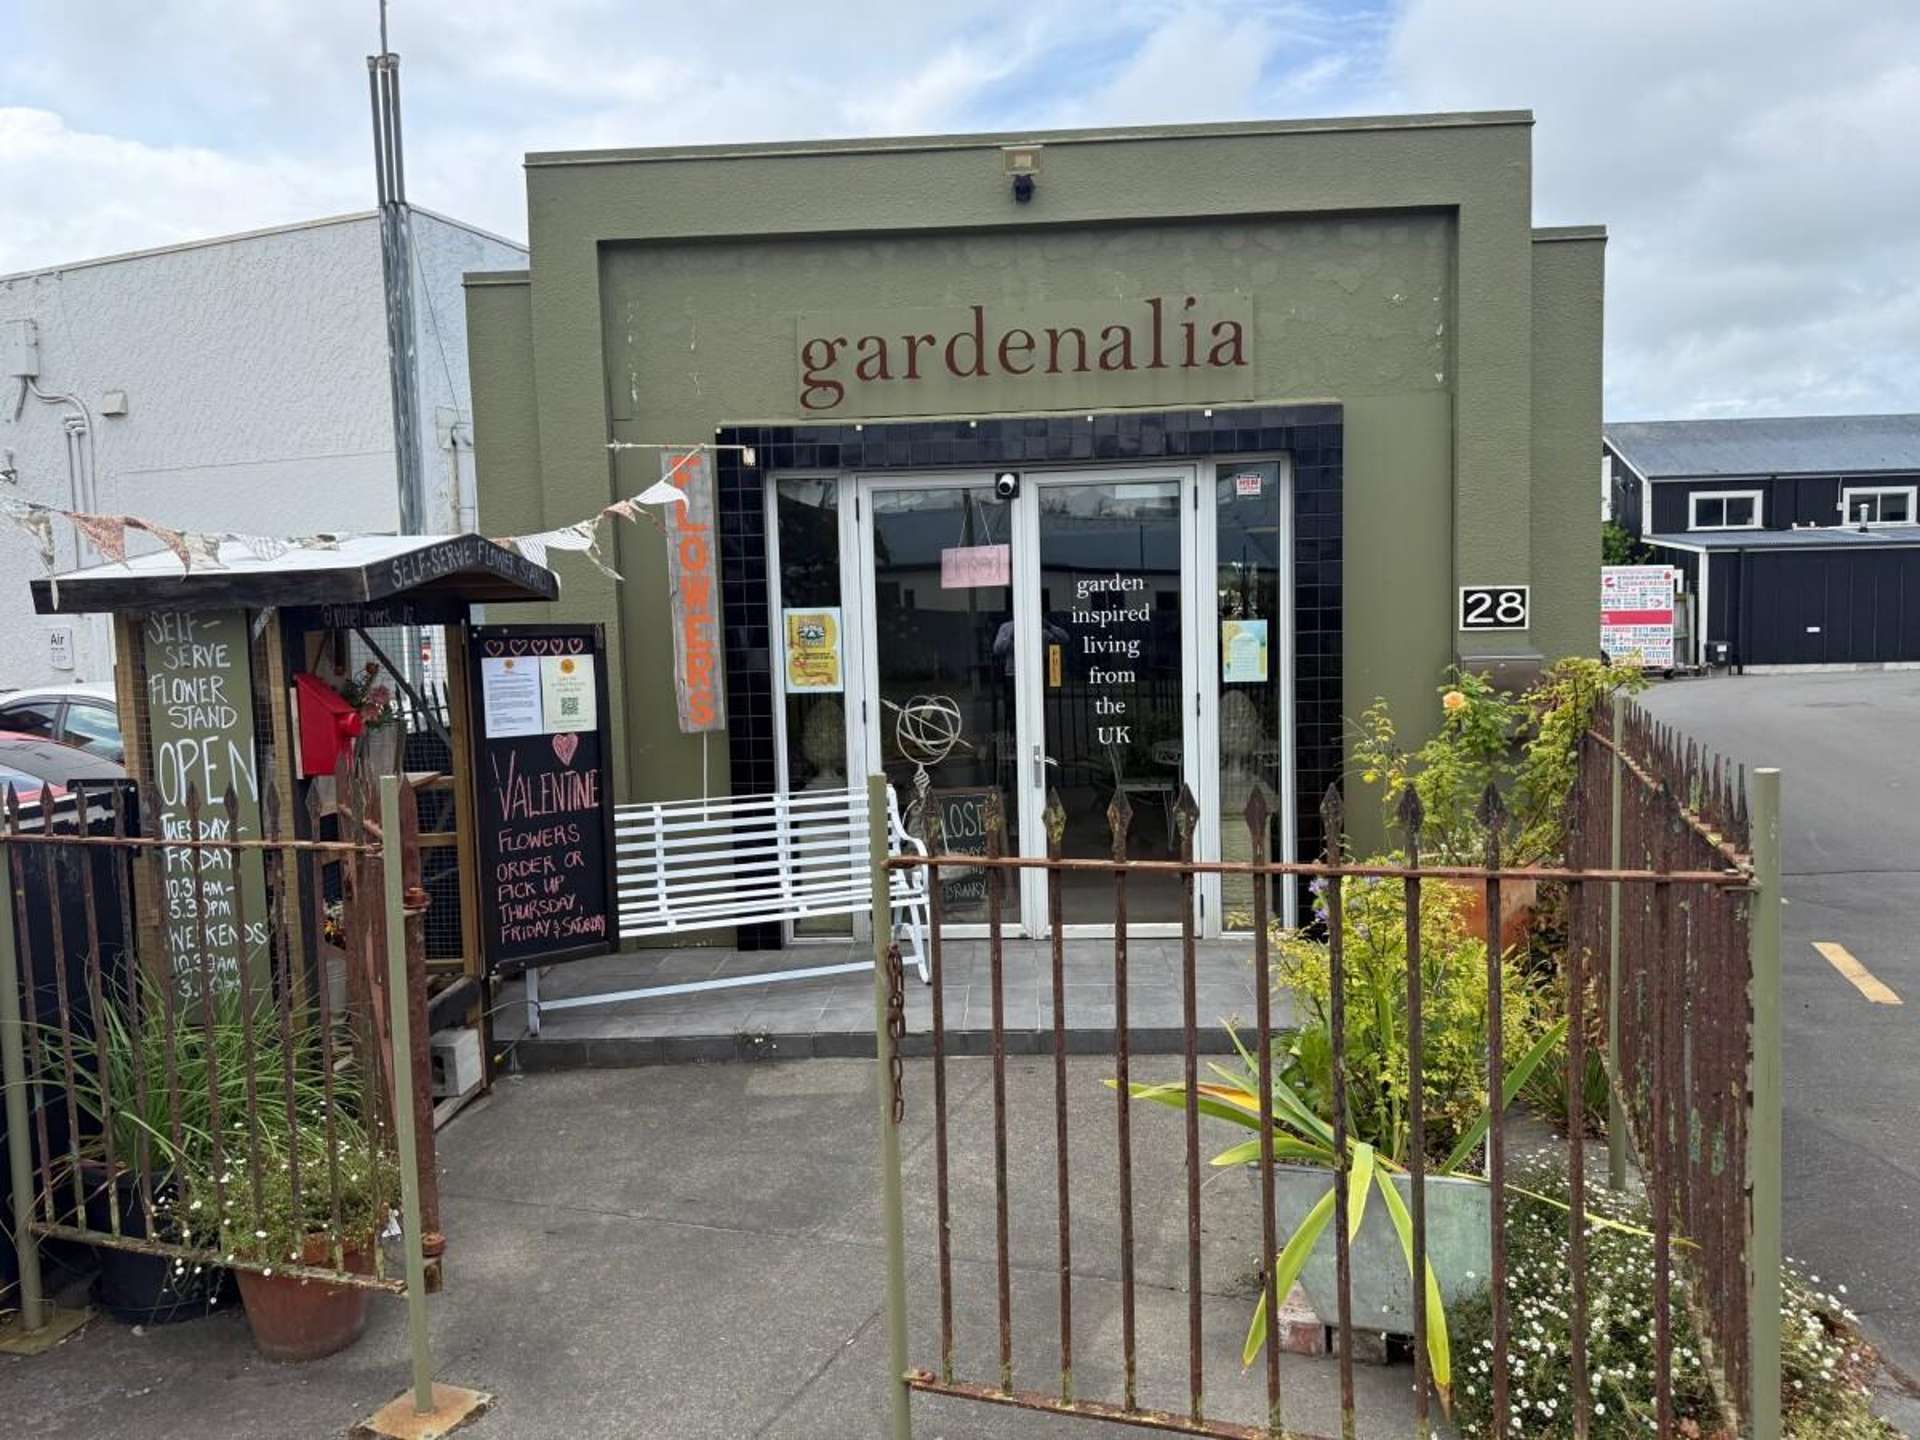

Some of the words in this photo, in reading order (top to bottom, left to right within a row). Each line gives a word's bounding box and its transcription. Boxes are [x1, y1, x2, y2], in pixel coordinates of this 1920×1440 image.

[800, 296, 1248, 410] gardenalia
[1077, 573, 1144, 599] garden
[1072, 602, 1151, 628] inspired
[1466, 591, 1525, 623] 28
[164, 643, 231, 670] SERVE
[1083, 635, 1141, 658] living
[148, 673, 228, 705] FLOWER
[1089, 666, 1136, 685] from
[168, 705, 238, 730] STAND
[1095, 697, 1126, 715] the
[1097, 726, 1131, 744] UK
[159, 735, 258, 807] OPEN
[491, 749, 599, 821] VALENTINE
[499, 823, 580, 853] FLOWERS
[164, 846, 233, 873] FRDAY
[496, 856, 556, 882] ORDER
[564, 850, 585, 869] OR
[498, 881, 537, 902] PICK
[543, 874, 565, 894] UP
[168, 922, 267, 952] WEKENDS
[501, 920, 551, 944] FRIDAY
